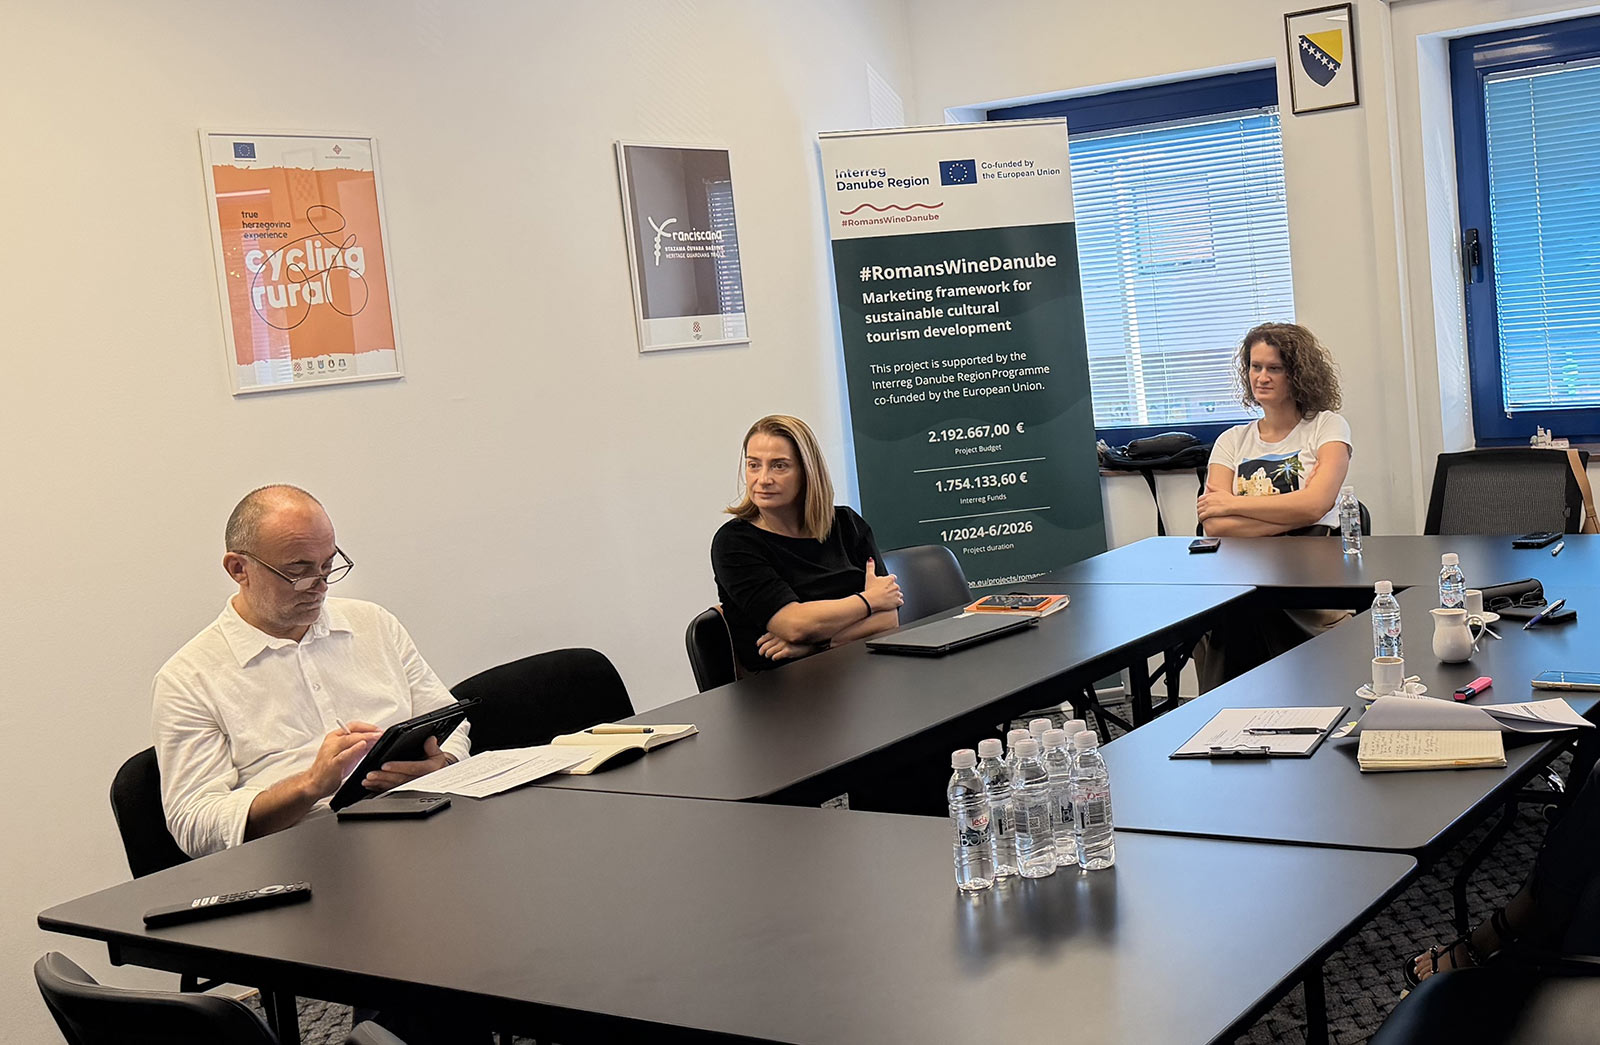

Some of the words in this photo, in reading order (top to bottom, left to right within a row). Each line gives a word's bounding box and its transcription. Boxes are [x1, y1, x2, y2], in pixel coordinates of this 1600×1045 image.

[835, 168, 886, 179] Interreg
[981, 160, 1022, 170] Co-funded
[1024, 159, 1034, 169] by
[982, 171, 995, 179] the
[997, 169, 1036, 180] European
[1037, 167, 1061, 176] Union
[836, 178, 884, 191] Danube
[888, 176, 930, 190] Region
[241, 210, 259, 219] true
[841, 213, 940, 227] #RomansWineDanube
[242, 220, 291, 231] herzegovina
[243, 230, 289, 240] experience
[245, 239, 367, 281] cycling
[860, 254, 1057, 281] #RomansWineDanube
[252, 273, 333, 310] rural
[862, 287, 934, 304] Marketing
[935, 280, 1011, 298] framework
[1012, 279, 1032, 292] for
[865, 306, 944, 324] sustainable
[946, 301, 1000, 317] cultural
[866, 326, 920, 344] tourism
[923, 319, 1012, 338] development
[870, 363, 892, 374] This
[893, 359, 929, 374] project
[931, 359, 940, 369] is
[941, 354, 994, 371] supported
[995, 352, 1008, 365] by
[1010, 351, 1027, 362] the
[872, 377, 913, 390] Interreg
[915, 374, 956, 387] Danube
[957, 370, 991, 384] Region
[992, 364, 1051, 380] Programme
[874, 391, 926, 406] co-funded
[928, 389, 942, 402] by
[943, 388, 961, 399] the
[962, 383, 1011, 398] European
[1012, 380, 1046, 392] Union.
[928, 423, 1010, 442] 2.192.667,00
[1016, 421, 1026, 434] €
[954, 446, 978, 456] Project
[978, 443, 1002, 454] Budget
[935, 473, 1017, 493] 1.754.133,60
[1019, 471, 1029, 484] €
[960, 495, 986, 505] Interreg
[987, 493, 1007, 502] Funds
[941, 522, 1033, 541] 1/2024-6/2026
[962, 545, 986, 555] Project
[986, 542, 1016, 553] duration
